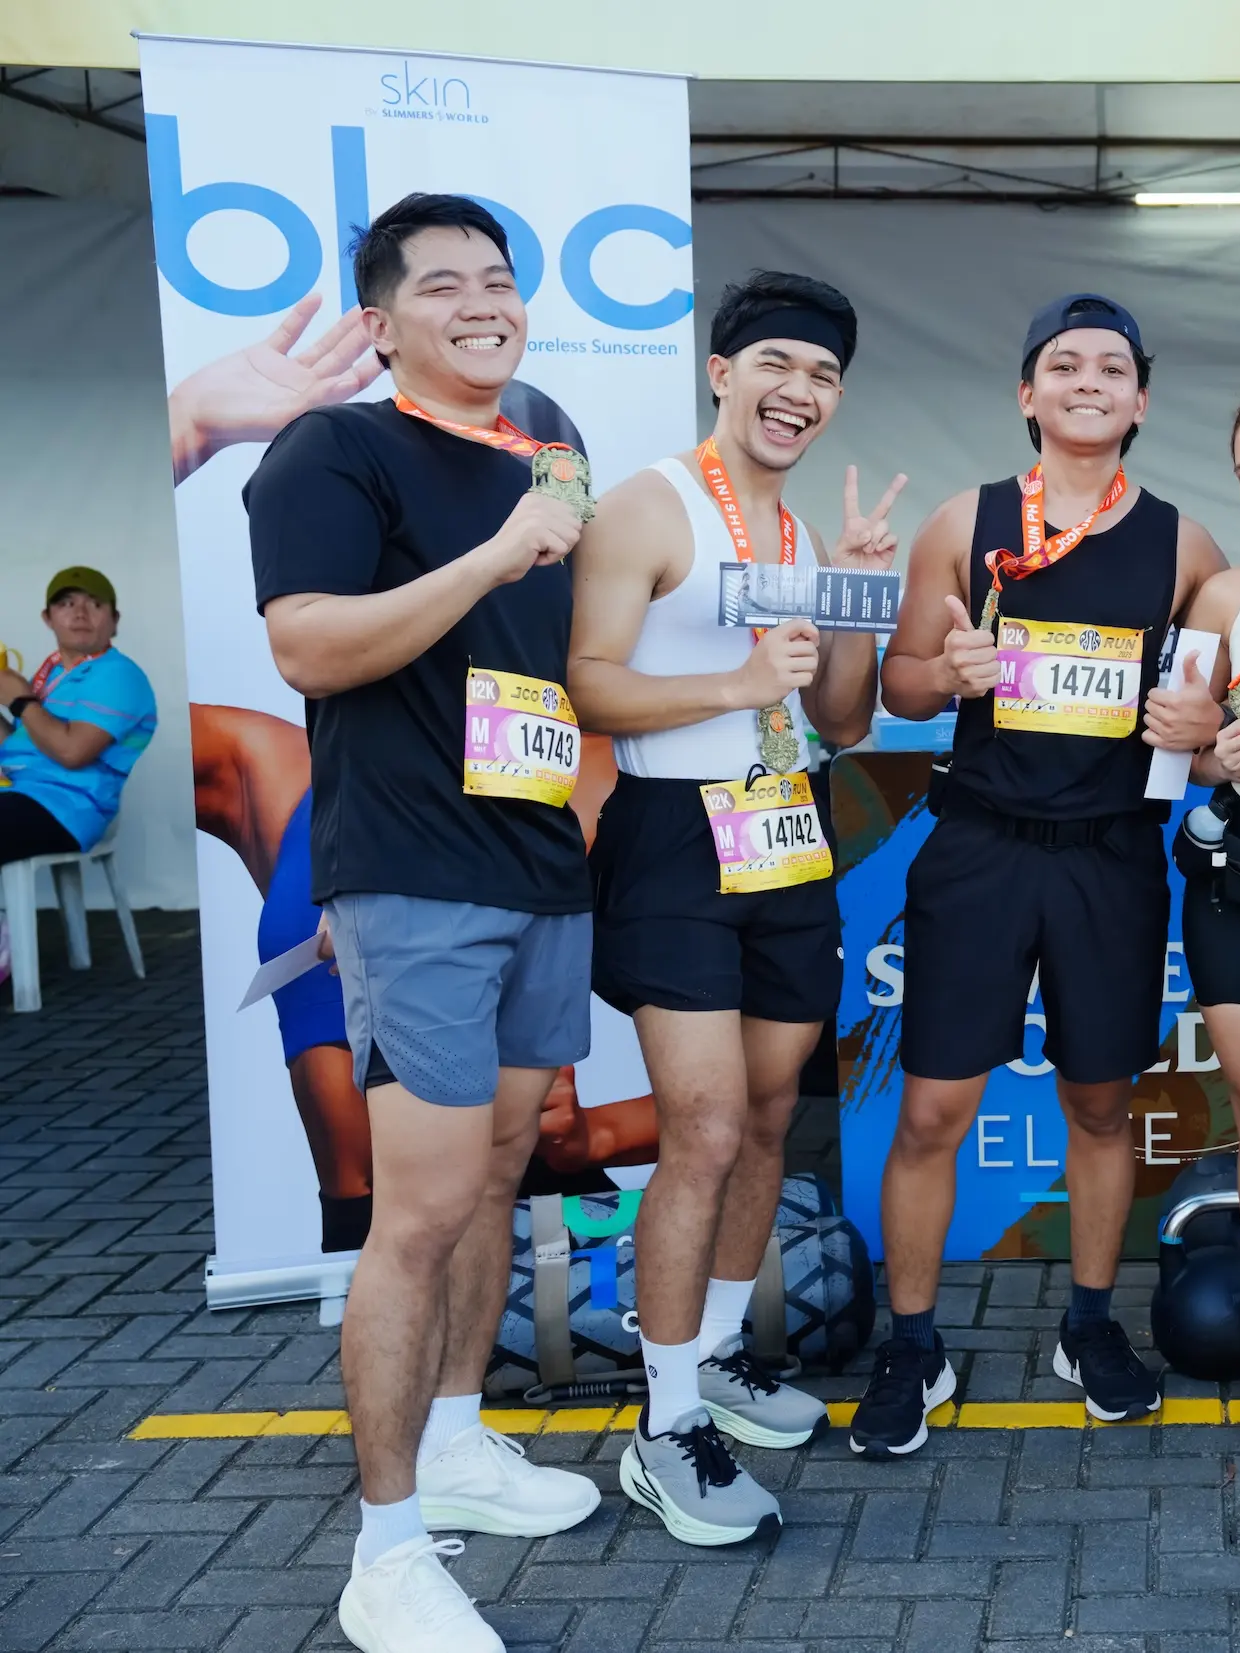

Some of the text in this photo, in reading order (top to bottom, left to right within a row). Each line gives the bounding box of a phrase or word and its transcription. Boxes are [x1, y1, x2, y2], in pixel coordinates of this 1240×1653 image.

[381, 60, 469, 109] skin
[382, 108, 434, 120] SLIMMERS
[446, 112, 490, 124] WORLD
[527, 337, 678, 356] oreless Sunscreen
[708, 468, 747, 548] FINISHER
[1026, 503, 1039, 523] PH
[1001, 628, 1026, 646] 12K
[1041, 632, 1137, 650] JCO RUN
[1117, 650, 1132, 659] 2025
[1000, 661, 1016, 685] M
[1050, 663, 1125, 700] 14741
[469, 679, 496, 701] 12K
[510, 687, 539, 703] JCO
[471, 716, 490, 745] M
[520, 722, 574, 768] 14743
[793, 783, 807, 796] RUN
[705, 791, 733, 811] 12K
[716, 824, 735, 850] M
[762, 812, 817, 850] 14742
